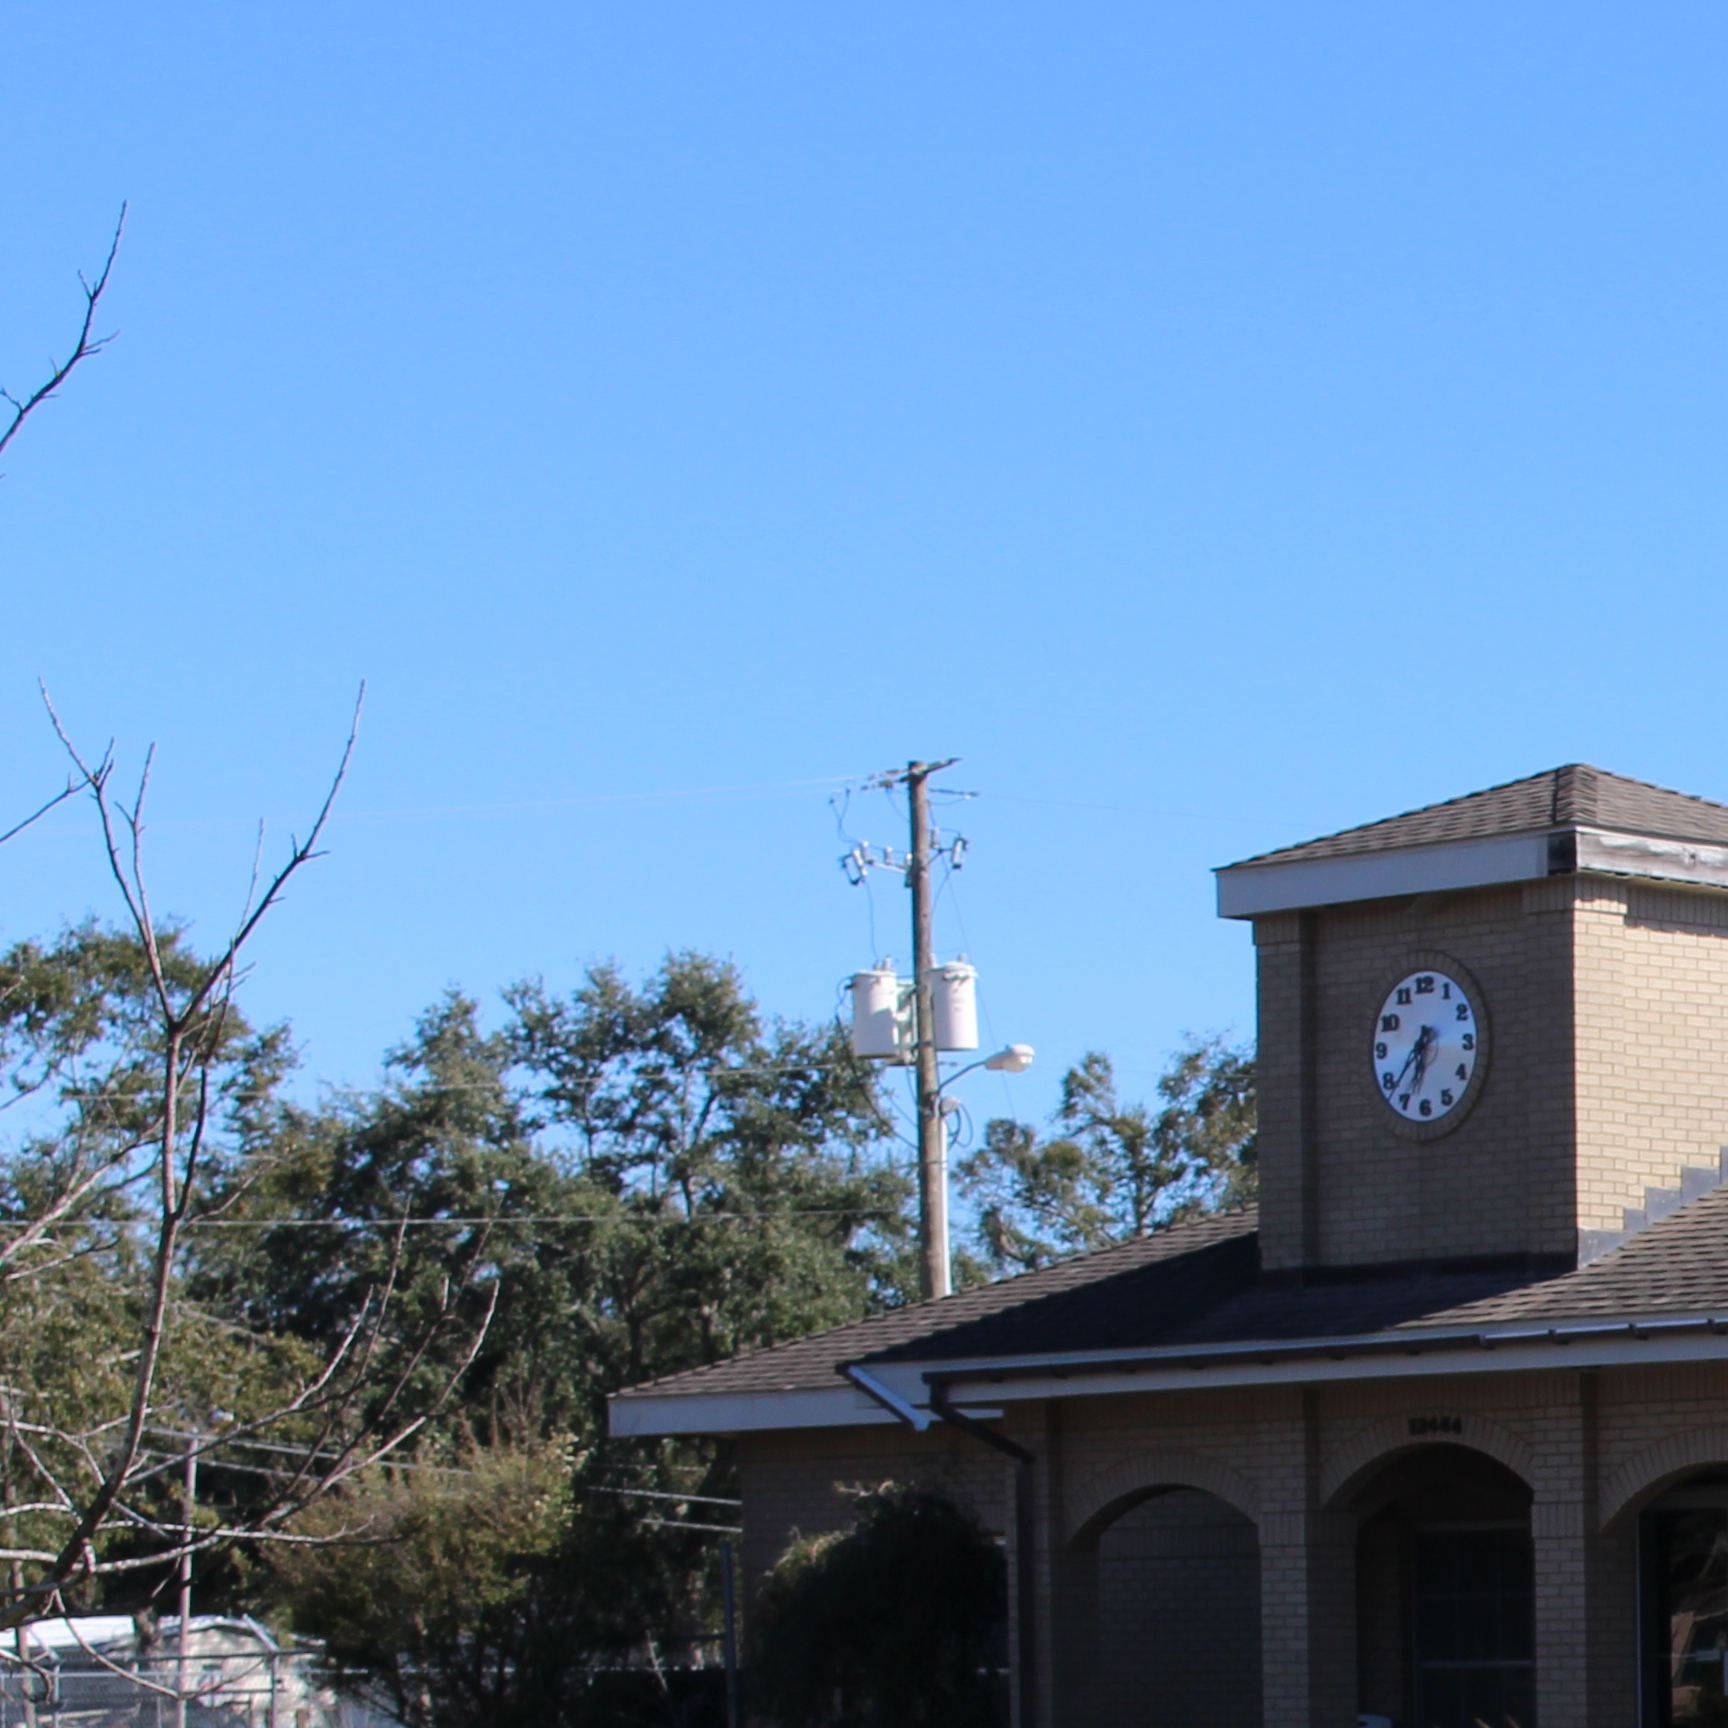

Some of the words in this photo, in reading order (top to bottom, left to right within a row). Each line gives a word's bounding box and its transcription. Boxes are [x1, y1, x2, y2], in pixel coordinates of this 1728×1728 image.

[1415, 976, 1434, 994] 12
[1442, 983, 1450, 1000] 1
[1396, 988, 1412, 1005] 11
[1456, 1004, 1468, 1021] 2
[1381, 1014, 1399, 1032] 10
[1376, 1042, 1388, 1059] 9
[1462, 1034, 1474, 1050] 3
[1456, 1064, 1467, 1080] 4
[1382, 1072, 1394, 1090] 8
[1399, 1094, 1411, 1110] 7
[1440, 1088, 1453, 1106] 5
[1420, 1100, 1431, 1116] 6
